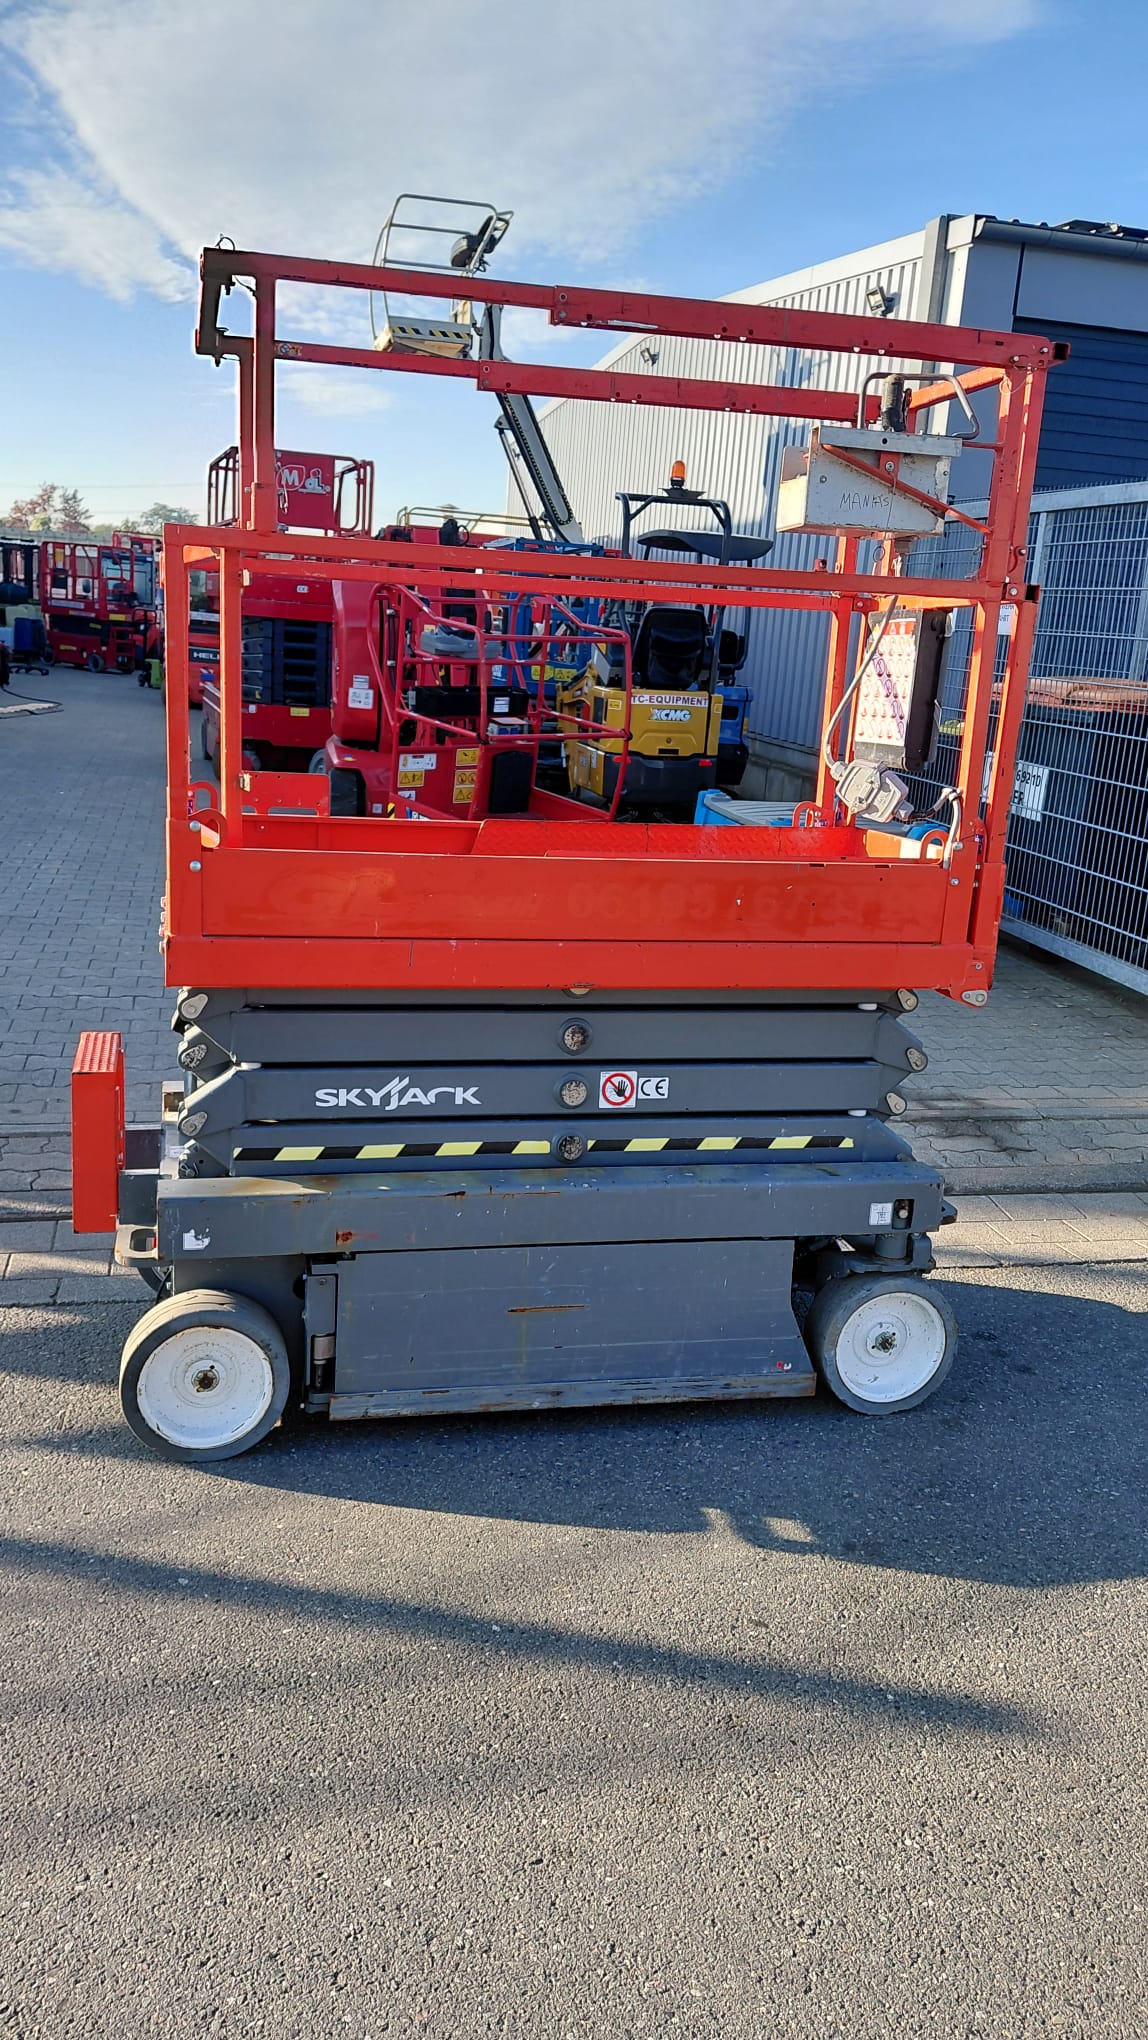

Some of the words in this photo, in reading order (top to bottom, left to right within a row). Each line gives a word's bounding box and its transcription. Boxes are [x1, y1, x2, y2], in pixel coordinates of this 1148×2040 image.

[650, 708, 691, 721] XCMG
[315, 1075, 482, 1111] SKYJACK
[641, 1079, 667, 1097] CE
